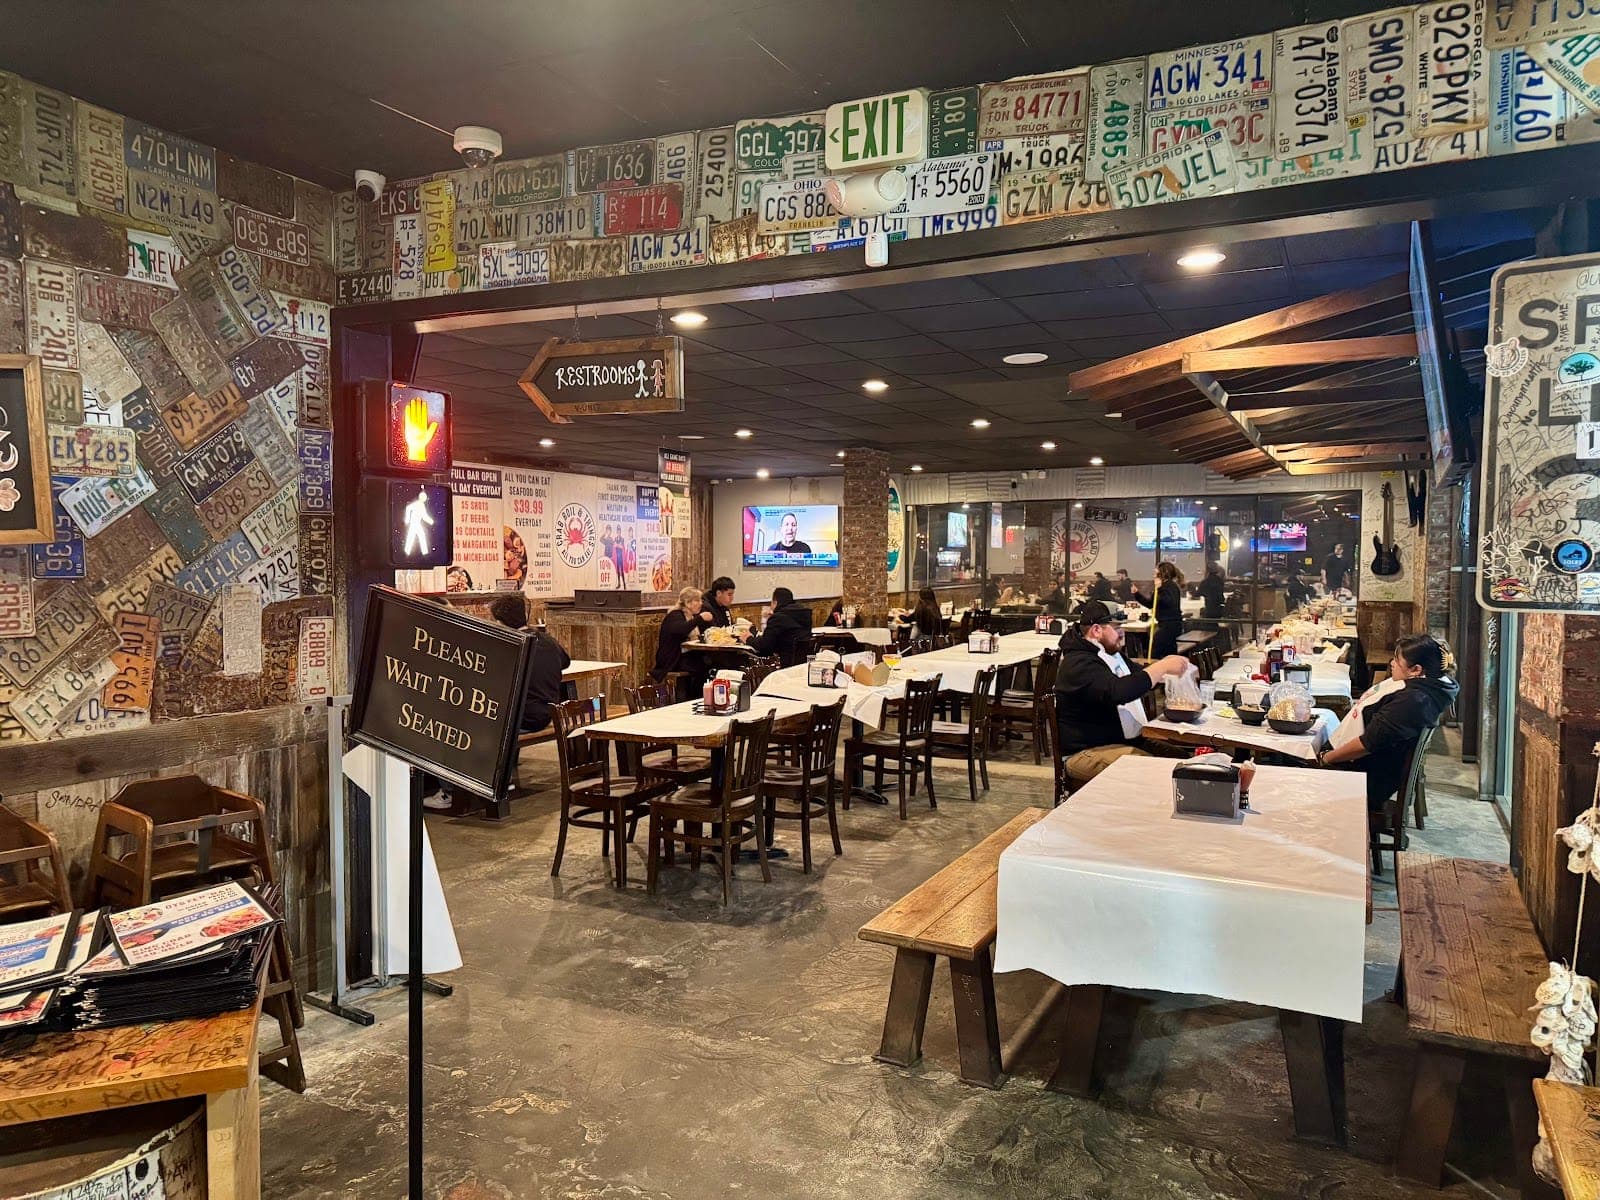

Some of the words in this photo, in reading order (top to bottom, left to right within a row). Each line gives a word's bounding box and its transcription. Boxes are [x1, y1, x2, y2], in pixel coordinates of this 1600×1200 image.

[1174, 41, 1245, 65] MINNESOTA
[1292, 36, 1326, 62] 47
[1106, 71, 1119, 96] TON
[1149, 59, 1203, 99] AGW
[1212, 48, 1265, 88] 341
[1418, 52, 1429, 90] WHITE
[1551, 59, 1594, 95] SUNSHINE
[1005, 83, 1030, 94] SOUTH
[1031, 79, 1068, 91] CAROLINA
[1207, 91, 1239, 102] LAKES
[1326, 51, 1340, 123] Alabama
[1348, 70, 1359, 104] TEXAS
[1358, 67, 1368, 101] TRUCK
[1496, 52, 1511, 117] Minnesota
[987, 110, 1010, 123] TON
[1013, 90, 1082, 121] 84771
[1179, 102, 1238, 121] FLORIDA
[1295, 83, 1329, 147] 0374
[842, 94, 910, 164] EXIT
[931, 99, 942, 159] CAROLINA
[945, 96, 967, 141] 180
[1016, 122, 1050, 134] TRUCK
[1132, 102, 1142, 139] TRUCK
[987, 141, 1004, 151] APR
[1021, 139, 1051, 150] TRUCK
[1137, 144, 1194, 170] FLORIDA
[605, 153, 646, 185] 1636
[705, 134, 729, 199] 25400
[916, 160, 967, 178] Alabama
[1271, 166, 1336, 186] BROWARD
[793, 180, 823, 196] OHIO
[935, 167, 985, 199] 5560
[1115, 171, 1169, 209] 502
[1180, 150, 1228, 190] JEL
[134, 181, 170, 216] N2M
[179, 194, 214, 226] 149
[380, 186, 408, 216] EKS
[508, 192, 551, 205] COLORADO
[639, 194, 670, 223] 114
[765, 196, 799, 222] CGS
[1007, 184, 1055, 219] GZM
[236, 213, 270, 247] 980
[276, 227, 308, 257] SBP
[256, 245, 289, 260] MISSOURI
[416, 233, 427, 283] KANSAS
[630, 231, 666, 262] AGW
[670, 229, 703, 257] 341
[668, 259, 689, 270] LAKES
[350, 273, 393, 297] 52440
[486, 278, 512, 288] NORTH
[513, 275, 548, 287] CAROLINA
[65, 286, 77, 346] FLORIDA
[300, 310, 327, 334] 112
[555, 365, 637, 390] RESTROOMS
[53, 436, 77, 460] EK
[93, 441, 130, 464] 285
[190, 429, 227, 462] MICHIGAN
[450, 469, 465, 480] FULL
[467, 471, 480, 481] BAR
[481, 472, 498, 483] OPEN
[504, 473, 515, 483] ALL
[516, 474, 528, 484] YOU
[528, 476, 540, 485] CAN
[541, 477, 551, 487] EAT
[129, 488, 147, 507] STATE
[459, 482, 471, 493] DAY
[472, 484, 502, 497] EVERYDAY
[508, 486, 534, 498] SEAFOOD
[535, 489, 548, 499] BOIL
[256, 489, 291, 519] GEORGIA
[470, 501, 489, 511] SHOTS
[513, 499, 544, 514] $39.99
[470, 514, 489, 524] BEERS
[515, 516, 543, 528] EVERYDAY
[556, 519, 569, 549] CRAB
[563, 506, 577, 522] BOIL
[583, 512, 597, 549] THINGS
[465, 527, 495, 537] COCKTAILS
[462, 540, 498, 550] MARGARITAS
[600, 573, 611, 585] OFF
[143, 641, 154, 663] YORK
[301, 637, 310, 686] FLORIDA
[140, 664, 150, 687] NEW
[84, 721, 117, 733] OHIO
